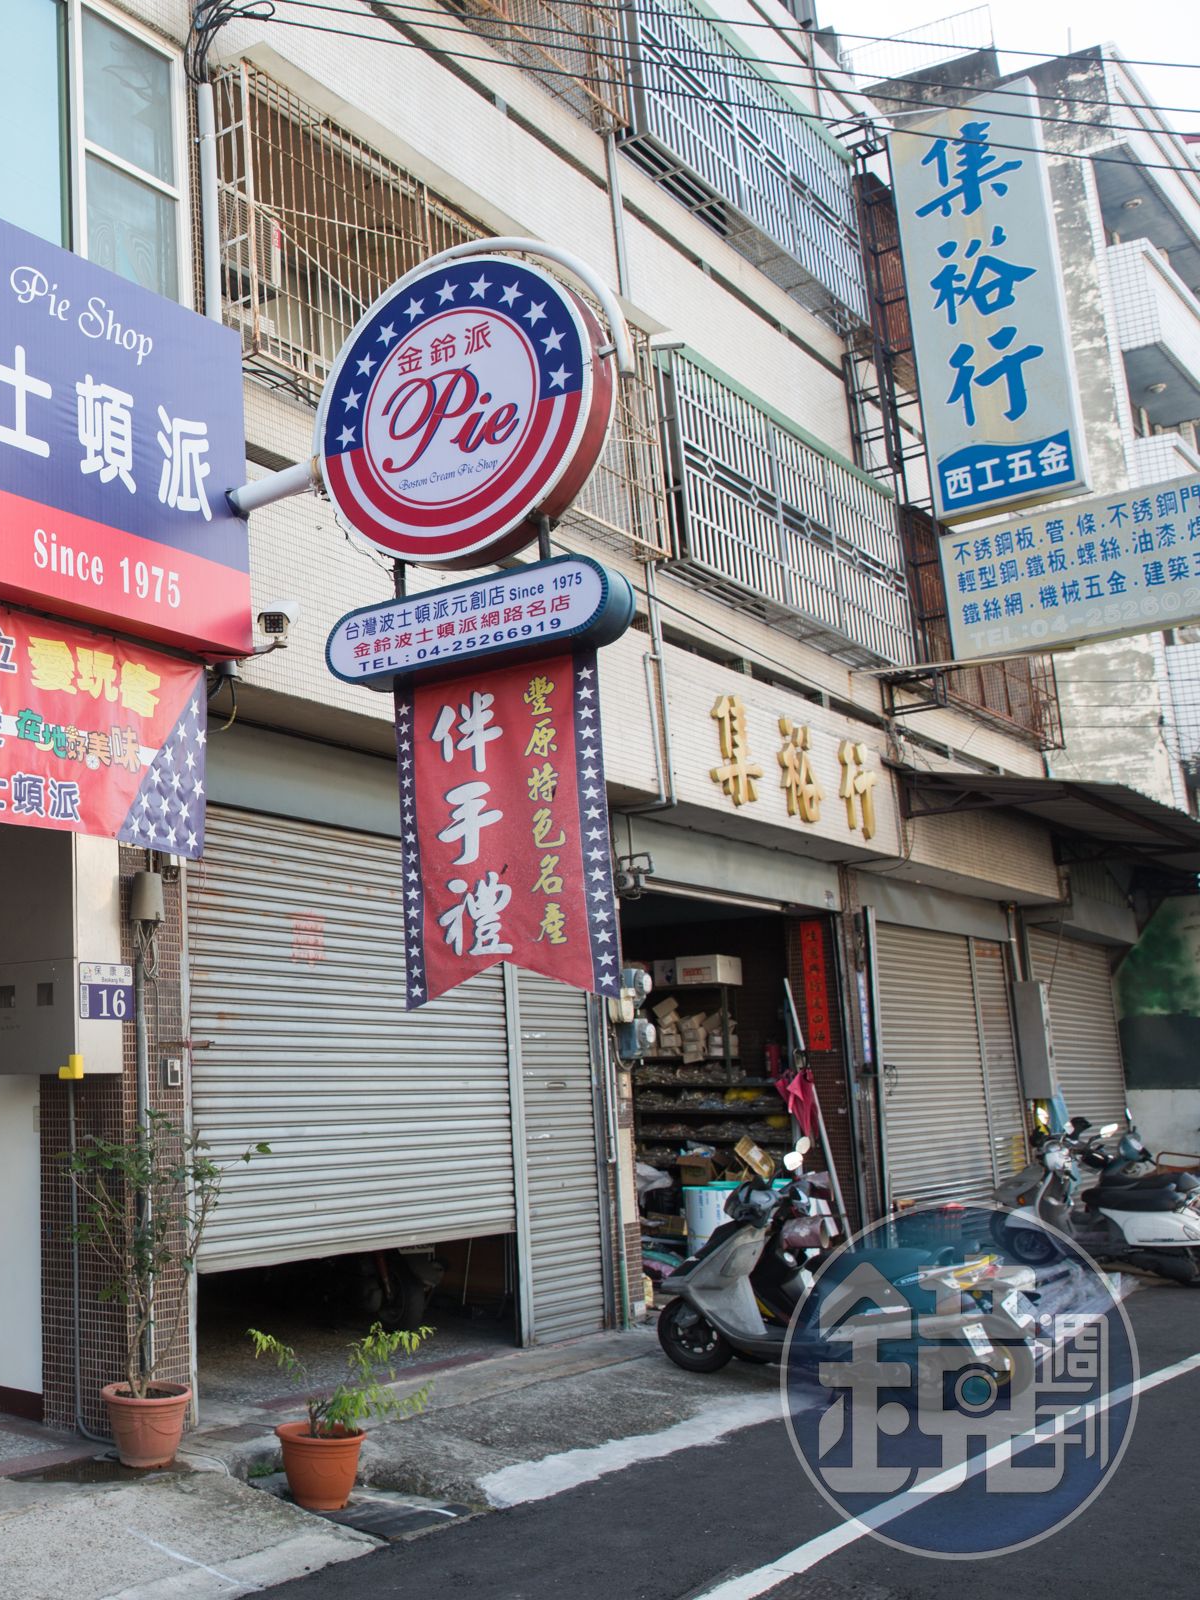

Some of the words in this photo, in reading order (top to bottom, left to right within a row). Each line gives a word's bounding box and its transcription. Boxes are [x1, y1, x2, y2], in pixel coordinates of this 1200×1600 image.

[914, 120, 1045, 427] 集裕行
[9, 265, 69, 321] Pie
[78, 297, 154, 366] Shop
[397, 321, 494, 376] 金鈴派
[381, 364, 520, 473] Pie
[398, 477, 428, 491] Boston
[429, 472, 456, 483] Cream
[457, 463, 475, 476] Pie
[475, 459, 499, 473] Shop
[944, 440, 1072, 500] 西工五金
[33, 528, 104, 586] Since
[119, 558, 181, 608] 1975
[344, 585, 506, 641] 台灣波士頓派元創店
[509, 582, 545, 601] Since
[552, 571, 583, 591] 1975
[353, 594, 571, 660] 金鈴波士頓派網路名店
[416, 617, 562, 660] 04-25266919
[27, 635, 161, 719] 愛玩客
[14, 709, 142, 774] 在地好美味
[709, 695, 877, 840] 集裕行
[431, 690, 513, 957] 伴手禮
[523, 675, 568, 945] 豐原特色名產
[98, 989, 126, 1017] 16
